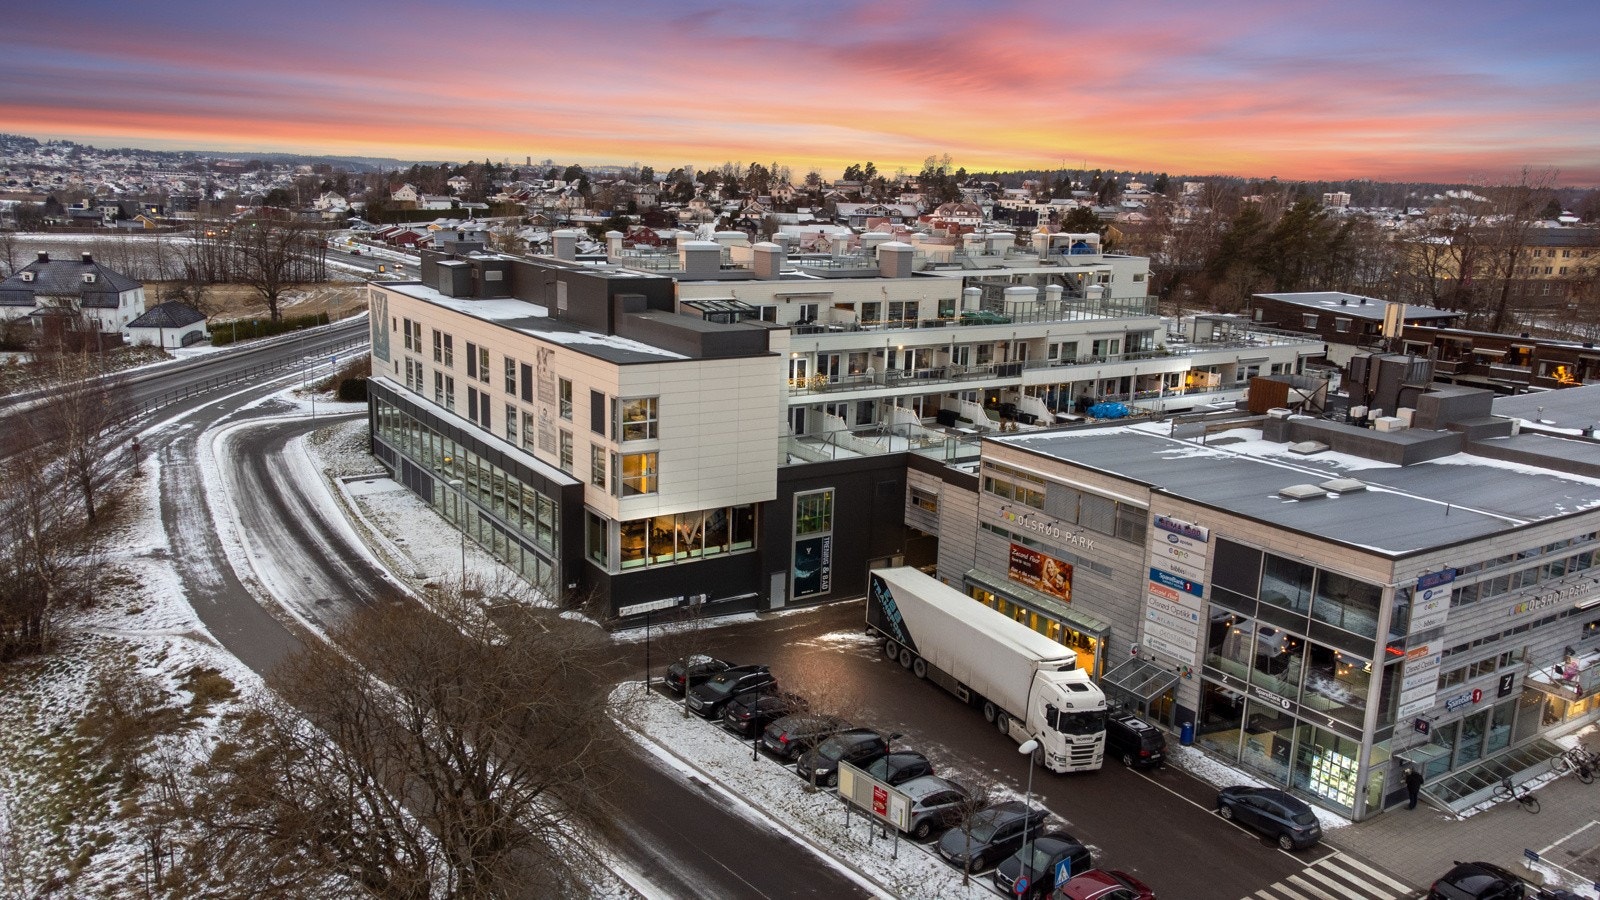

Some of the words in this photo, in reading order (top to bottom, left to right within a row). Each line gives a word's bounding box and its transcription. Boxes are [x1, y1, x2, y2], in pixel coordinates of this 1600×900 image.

[1018, 515, 1060, 538] OLSRØD
[1065, 531, 1095, 551] PARK
[1159, 572, 1185, 586] SpareBank
[1569, 581, 1590, 600] PARK
[1148, 597, 1170, 611] Olsrød
[1171, 605, 1191, 619] Optikk
